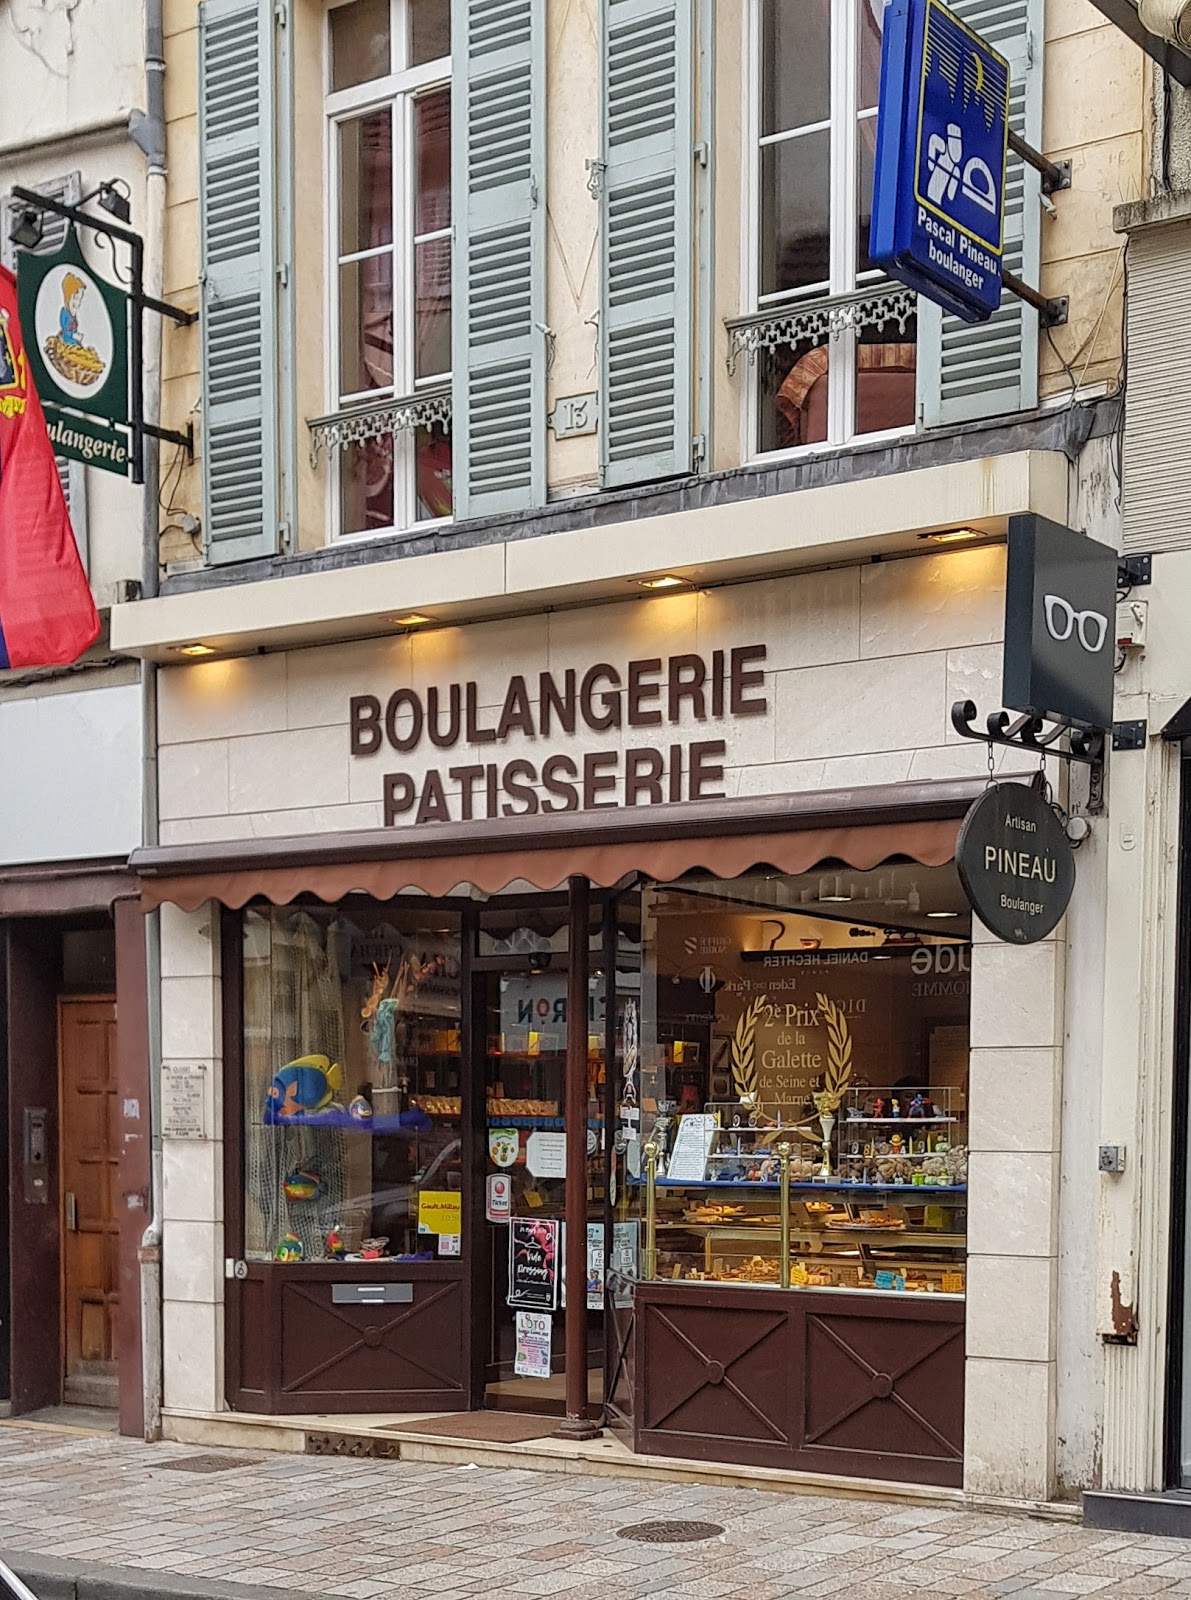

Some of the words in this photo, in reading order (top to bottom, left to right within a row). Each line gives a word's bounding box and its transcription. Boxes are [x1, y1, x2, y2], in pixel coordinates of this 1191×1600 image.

[917, 205, 955, 249] Pascal
[928, 239, 984, 290] boulanger
[563, 401, 588, 430] 13
[46, 420, 126, 463] ulangerie
[348, 643, 767, 756] BOULANGERIE
[383, 739, 726, 827] PATISSERIE
[1005, 814, 1037, 833] Artisan
[985, 845, 1056, 883] PINEAU
[1000, 894, 1044, 916] Boulanger
[784, 1003, 820, 1027] Prix
[777, 1031, 792, 1046] de
[795, 1031, 806, 1046] la
[761, 1050, 822, 1070] Galette
[759, 1075, 773, 1088] de
[775, 1075, 806, 1088] Seine
[808, 1076, 820, 1088] et
[774, 1092, 810, 1104] Marne
